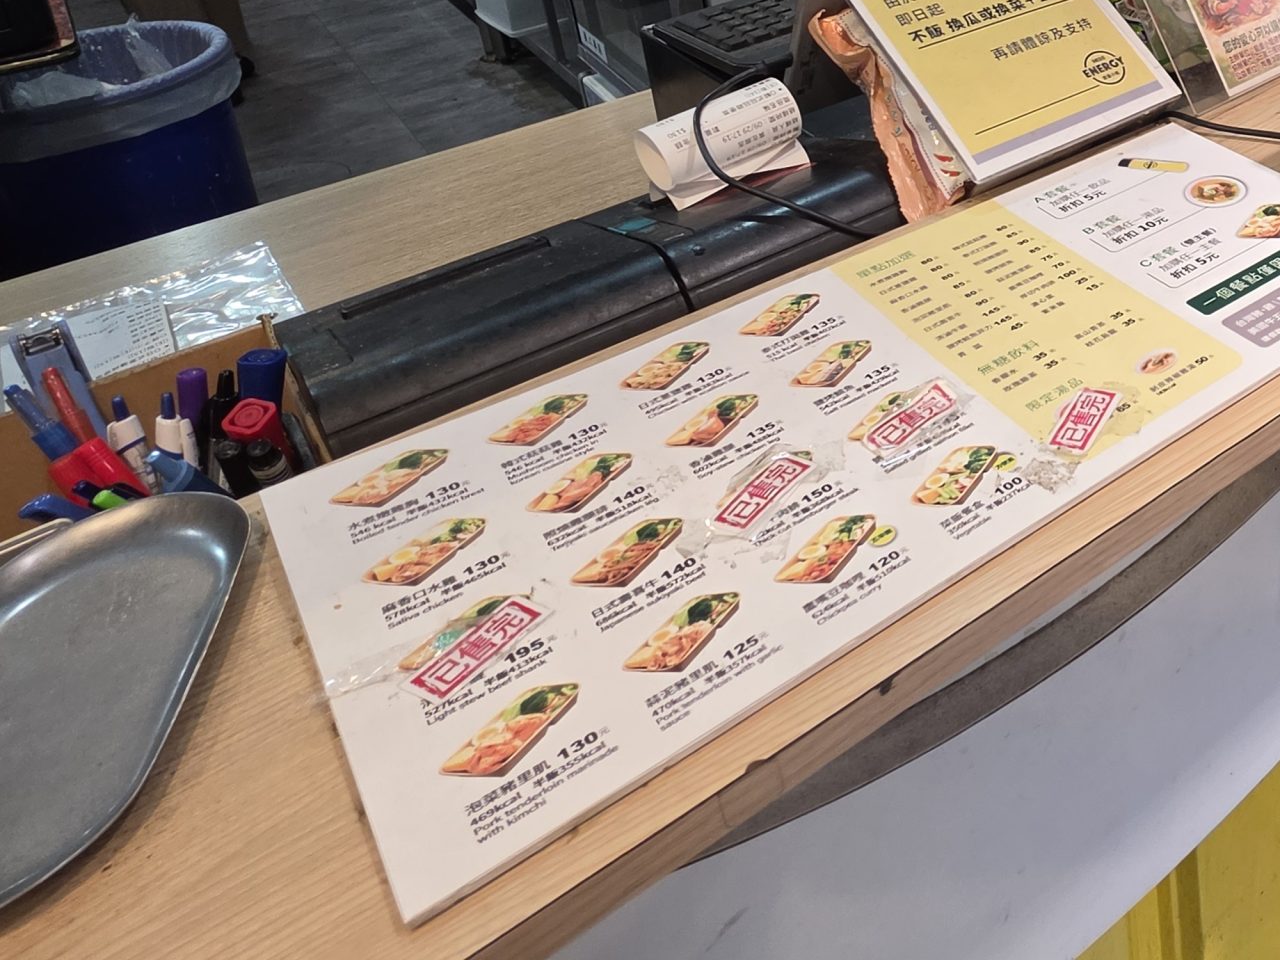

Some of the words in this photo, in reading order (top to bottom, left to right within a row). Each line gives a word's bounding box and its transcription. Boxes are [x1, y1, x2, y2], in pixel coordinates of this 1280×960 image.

[895, 3, 945, 27] 即日起
[991, 18, 1092, 61] 再請體諒及支持
[1083, 56, 1124, 79] ENERGY
[877, 395, 947, 446] 已售完
[1061, 392, 1107, 443] 已售完
[727, 461, 798, 527] 已售完
[424, 610, 527, 685] 已售完
